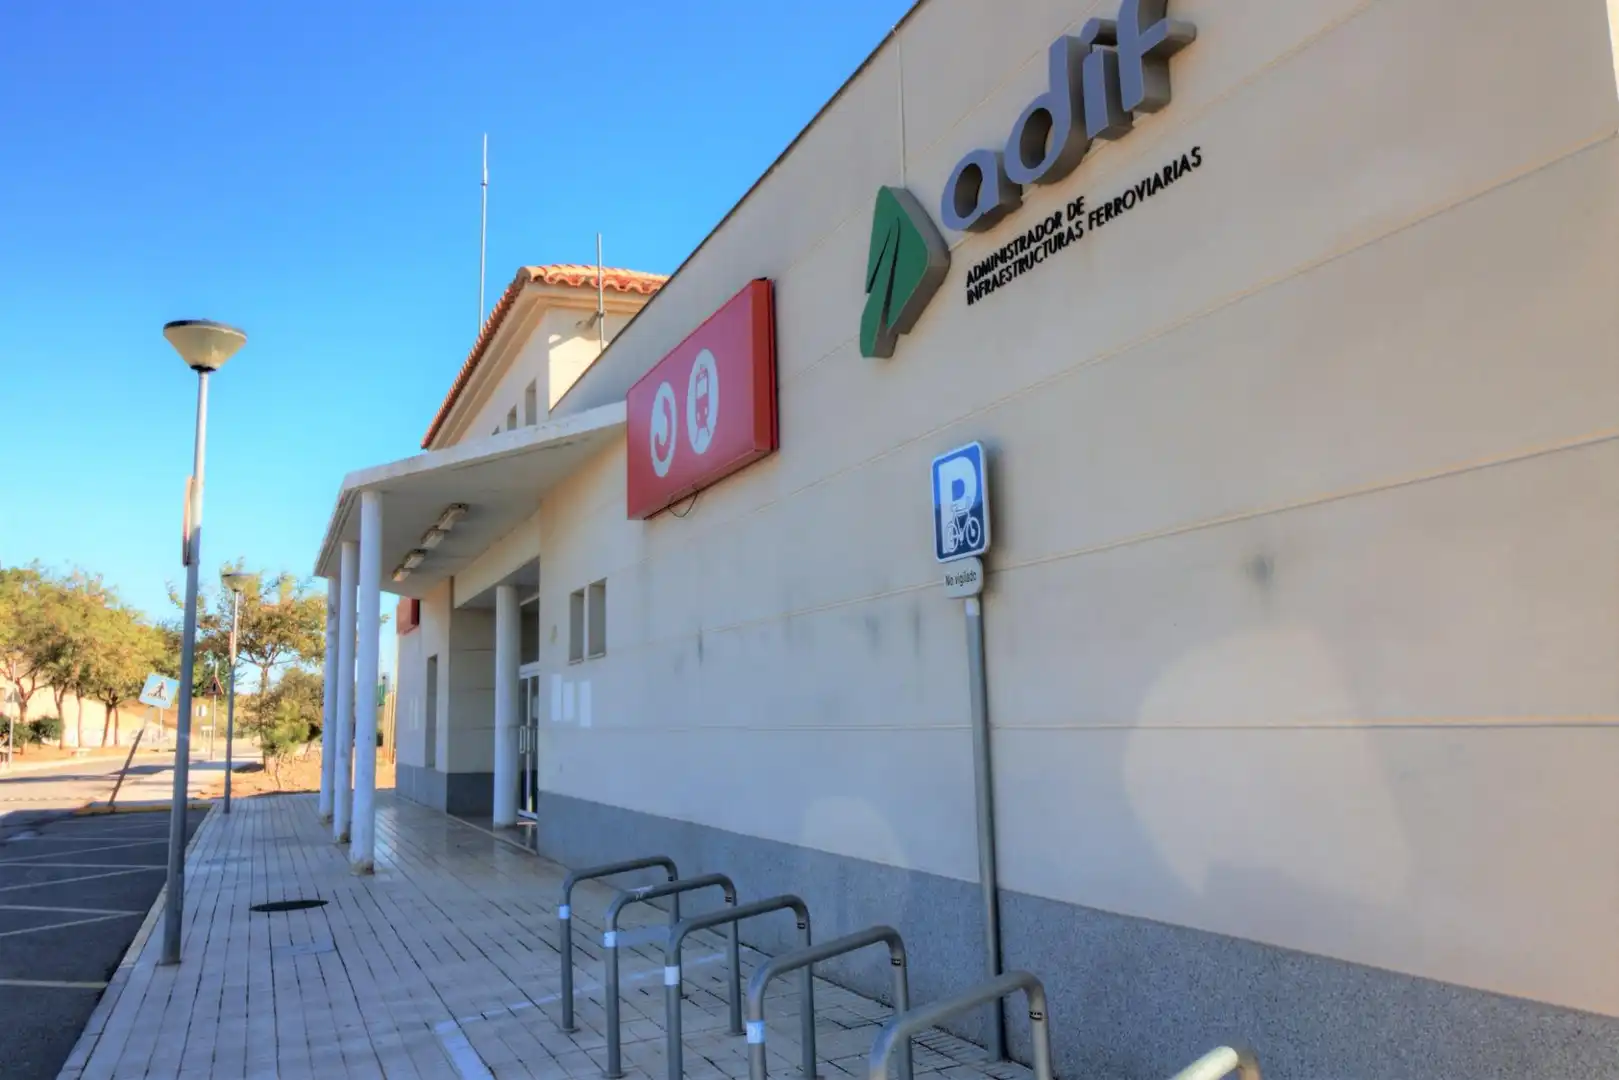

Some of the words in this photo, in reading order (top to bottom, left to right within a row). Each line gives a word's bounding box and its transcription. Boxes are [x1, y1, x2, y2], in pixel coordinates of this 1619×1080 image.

[941, 0, 1176, 231] adif
[966, 221, 1083, 305] INFRAESTRUCTURAS
[1088, 146, 1202, 231] FERROVIARIAS
[966, 211, 1063, 288] ADMINISTRADOR
[1066, 196, 1084, 221] DE
[938, 456, 976, 554] P
[945, 575, 954, 587] No
[955, 569, 977, 587] vigilado
